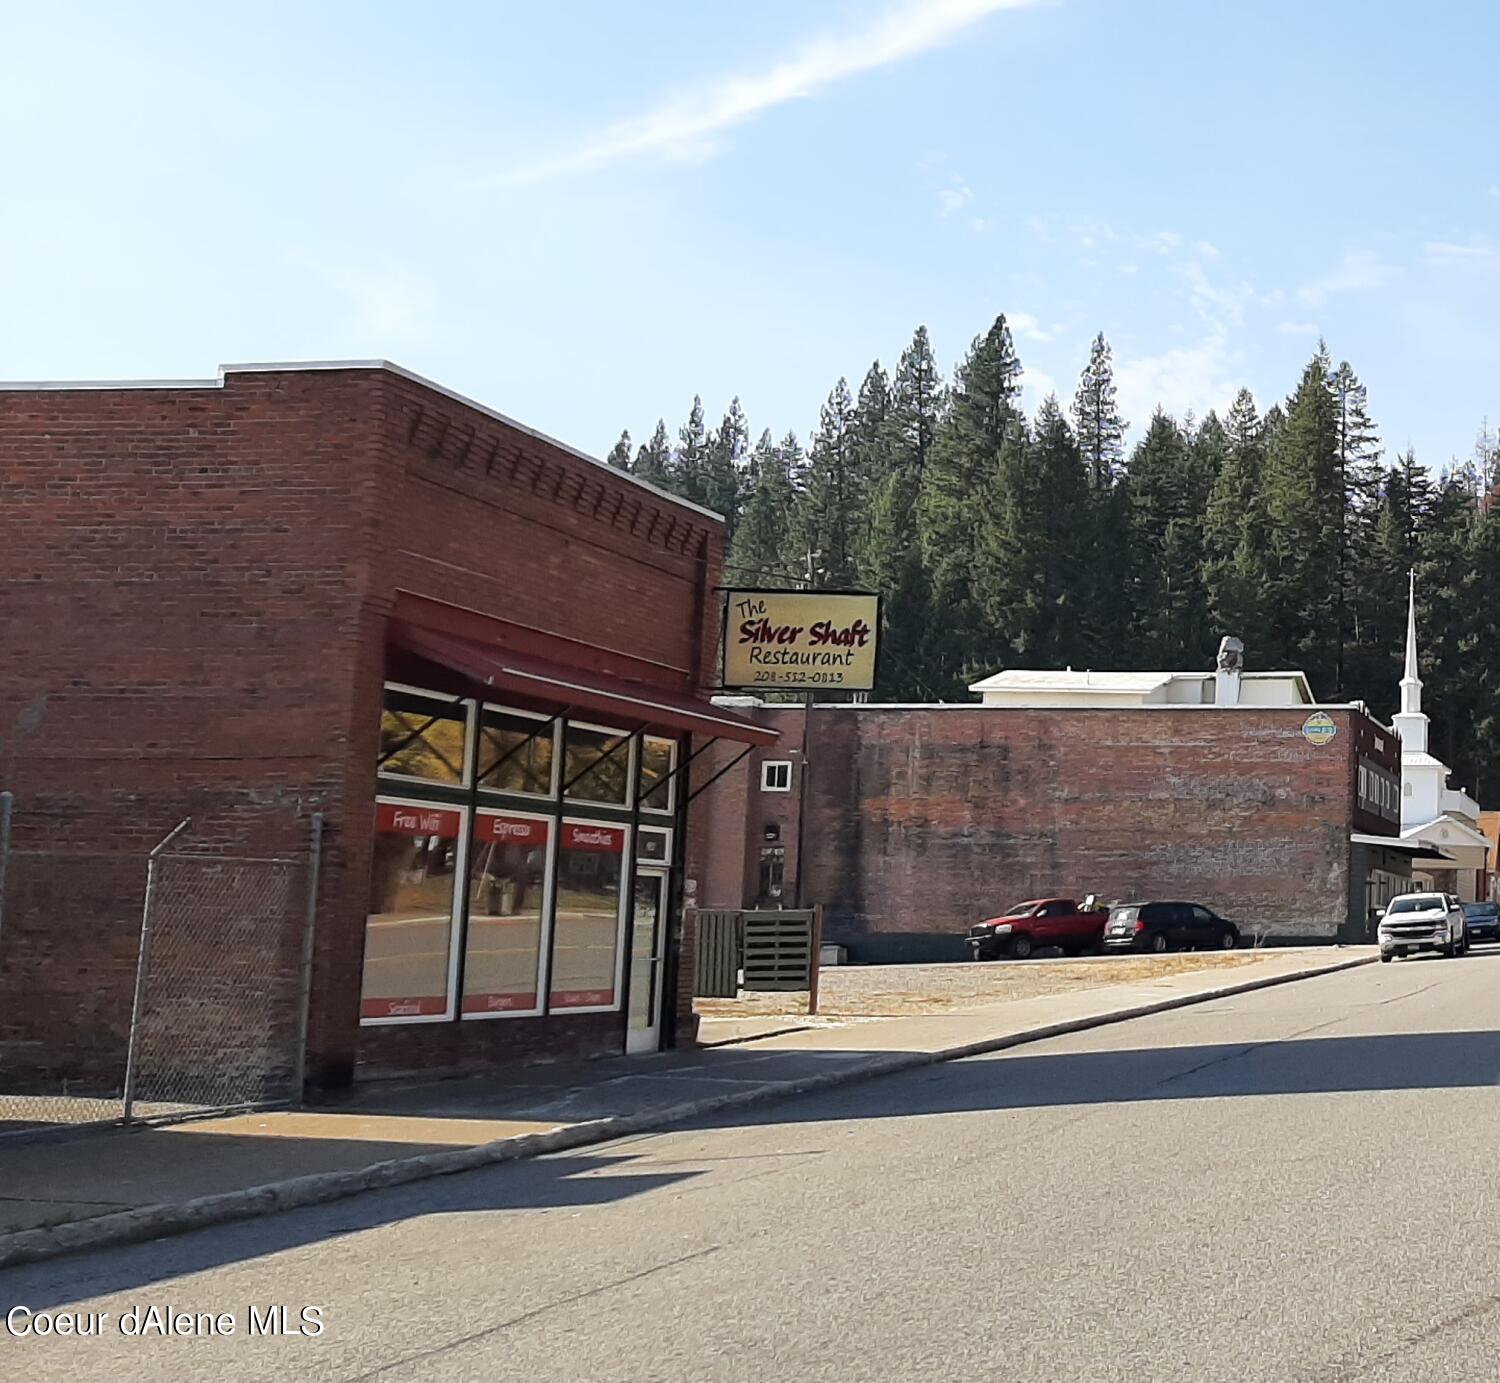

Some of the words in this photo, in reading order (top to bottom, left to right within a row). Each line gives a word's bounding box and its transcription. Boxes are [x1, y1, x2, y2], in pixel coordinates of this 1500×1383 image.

[736, 599, 767, 618] The
[738, 617, 804, 644] Silver
[808, 619, 870, 647] Shaft
[749, 646, 855, 666] Restaurant
[393, 810, 417, 829] Free
